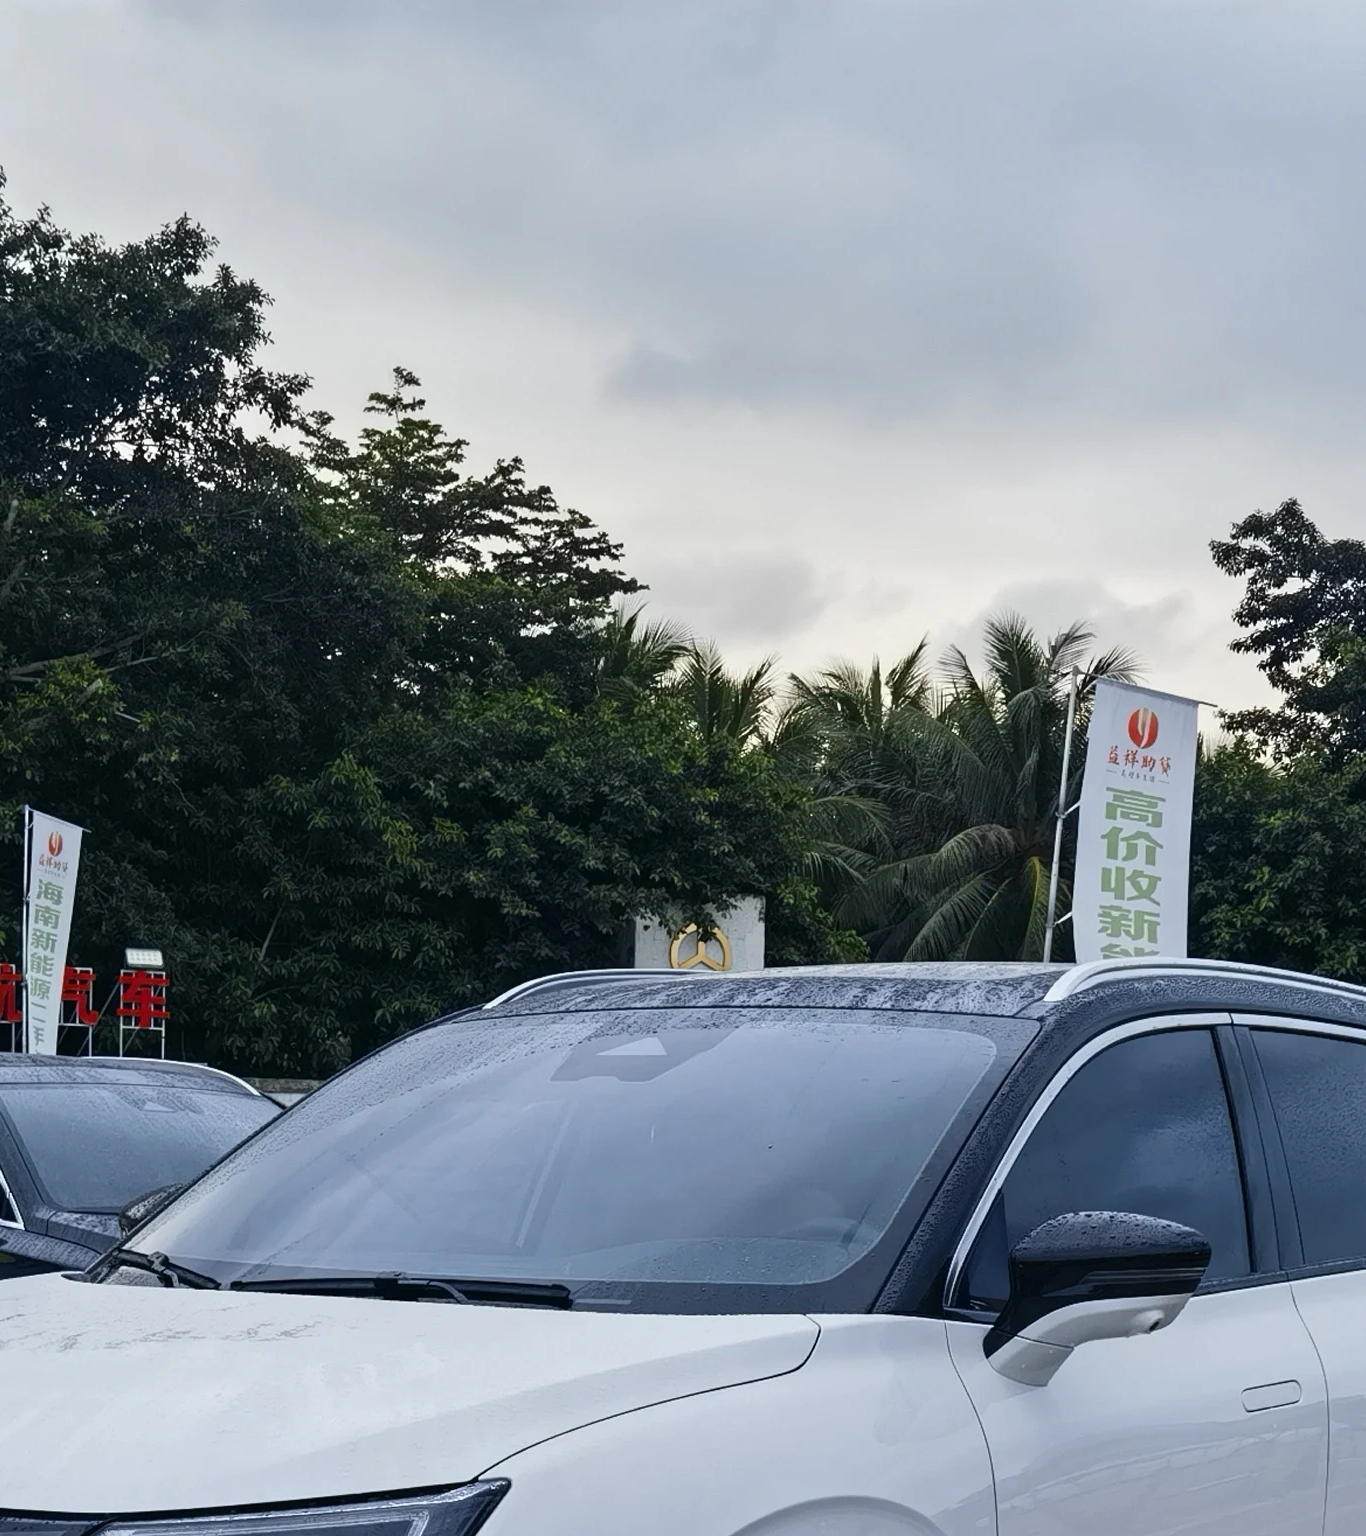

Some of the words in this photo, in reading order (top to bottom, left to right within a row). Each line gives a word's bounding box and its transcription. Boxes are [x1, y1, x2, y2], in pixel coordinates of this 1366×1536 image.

[30, 878, 64, 1054] 海南新能源二手
